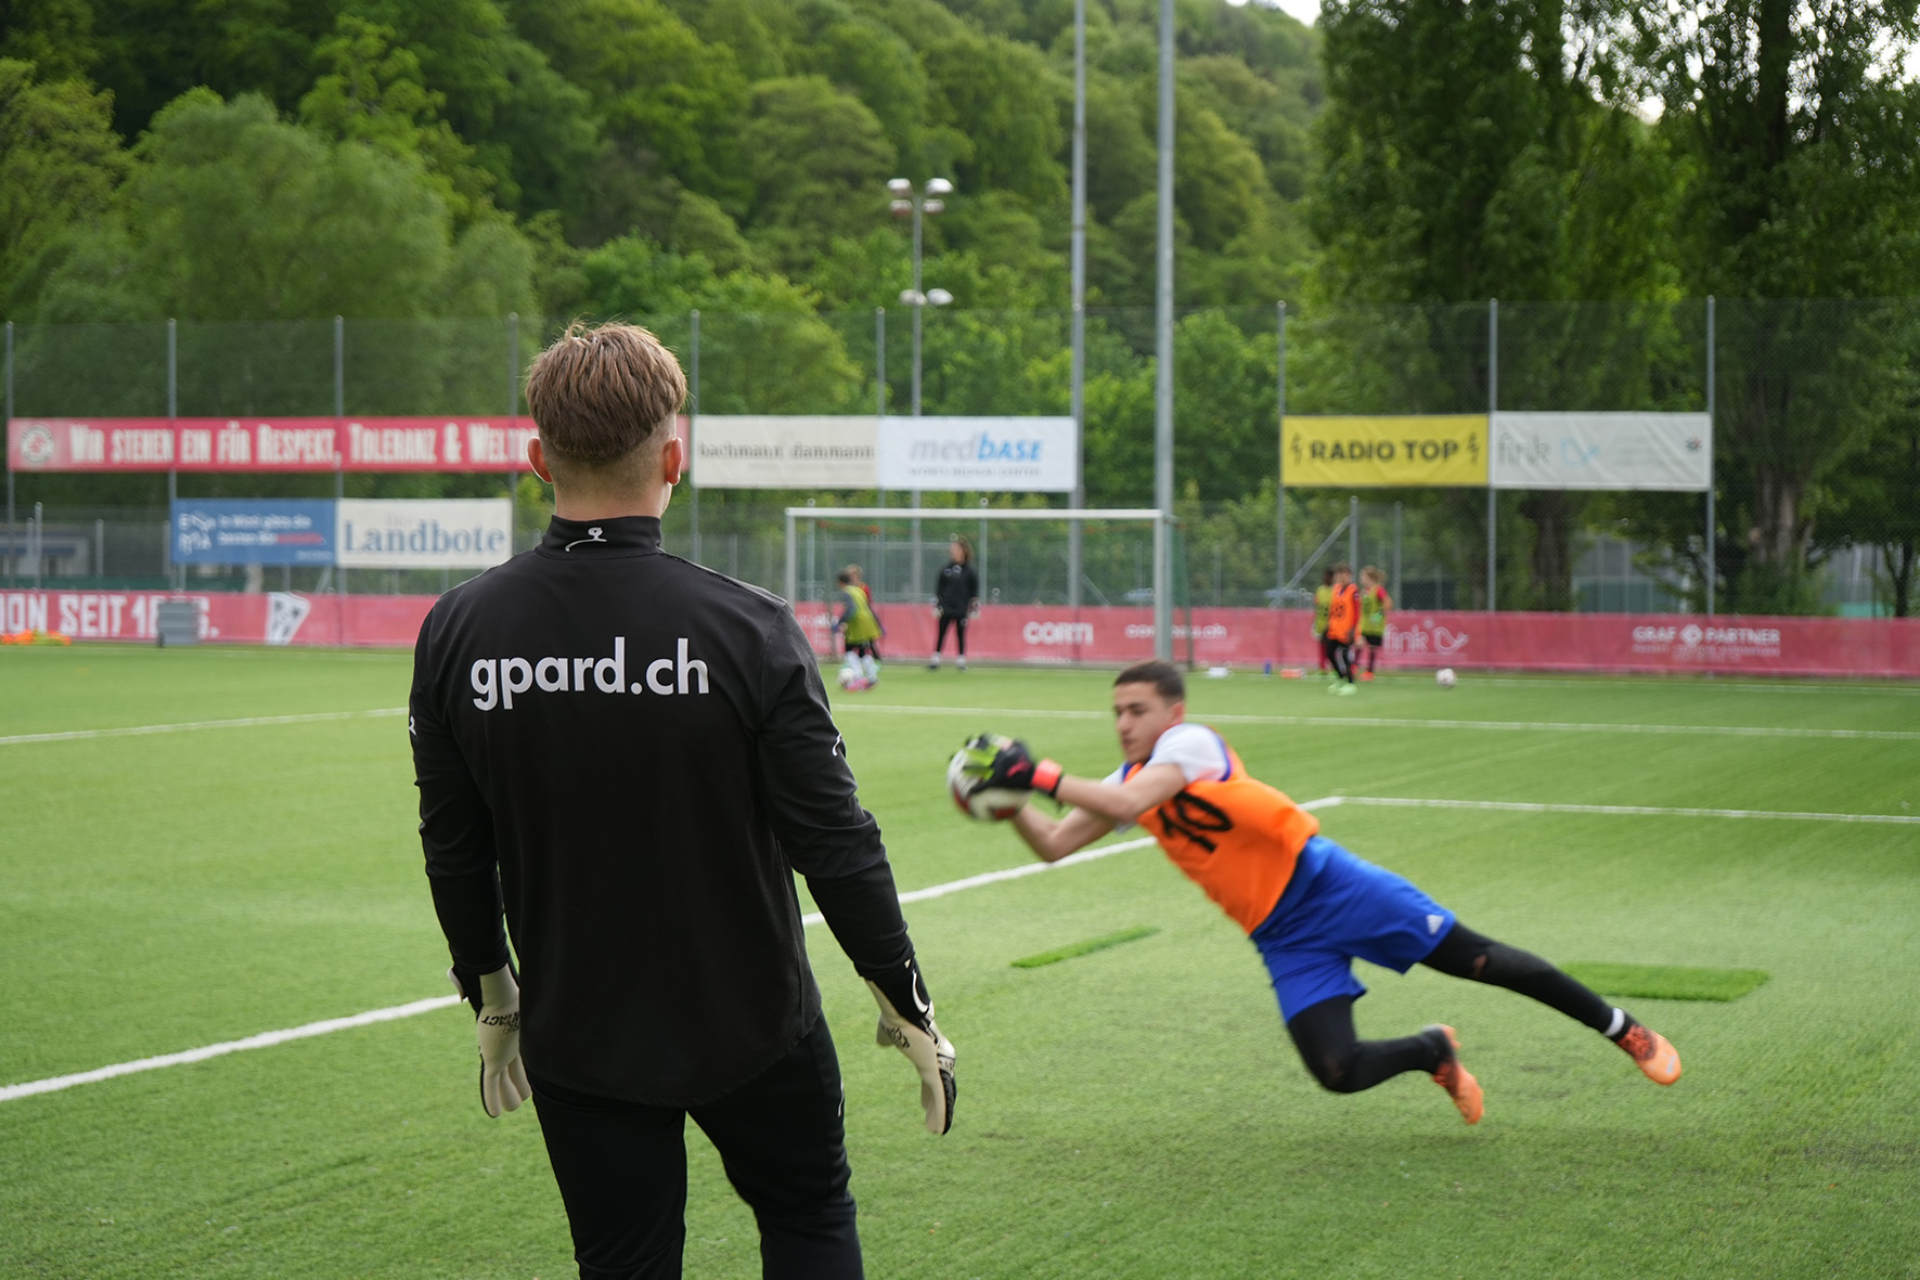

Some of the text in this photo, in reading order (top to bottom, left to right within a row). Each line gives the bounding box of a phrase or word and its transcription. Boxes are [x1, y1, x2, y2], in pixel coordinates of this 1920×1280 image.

[443, 422, 462, 464] &
[1309, 440, 1458, 461] RADIO TOP
[344, 519, 506, 553] Landbote
[60, 593, 127, 637] SEIT
[1022, 621, 1094, 646] CORTI
[1632, 625, 1781, 645] GRAF PARTNER
[470, 636, 709, 711] gpard.ch
[1157, 790, 1233, 853] 10
